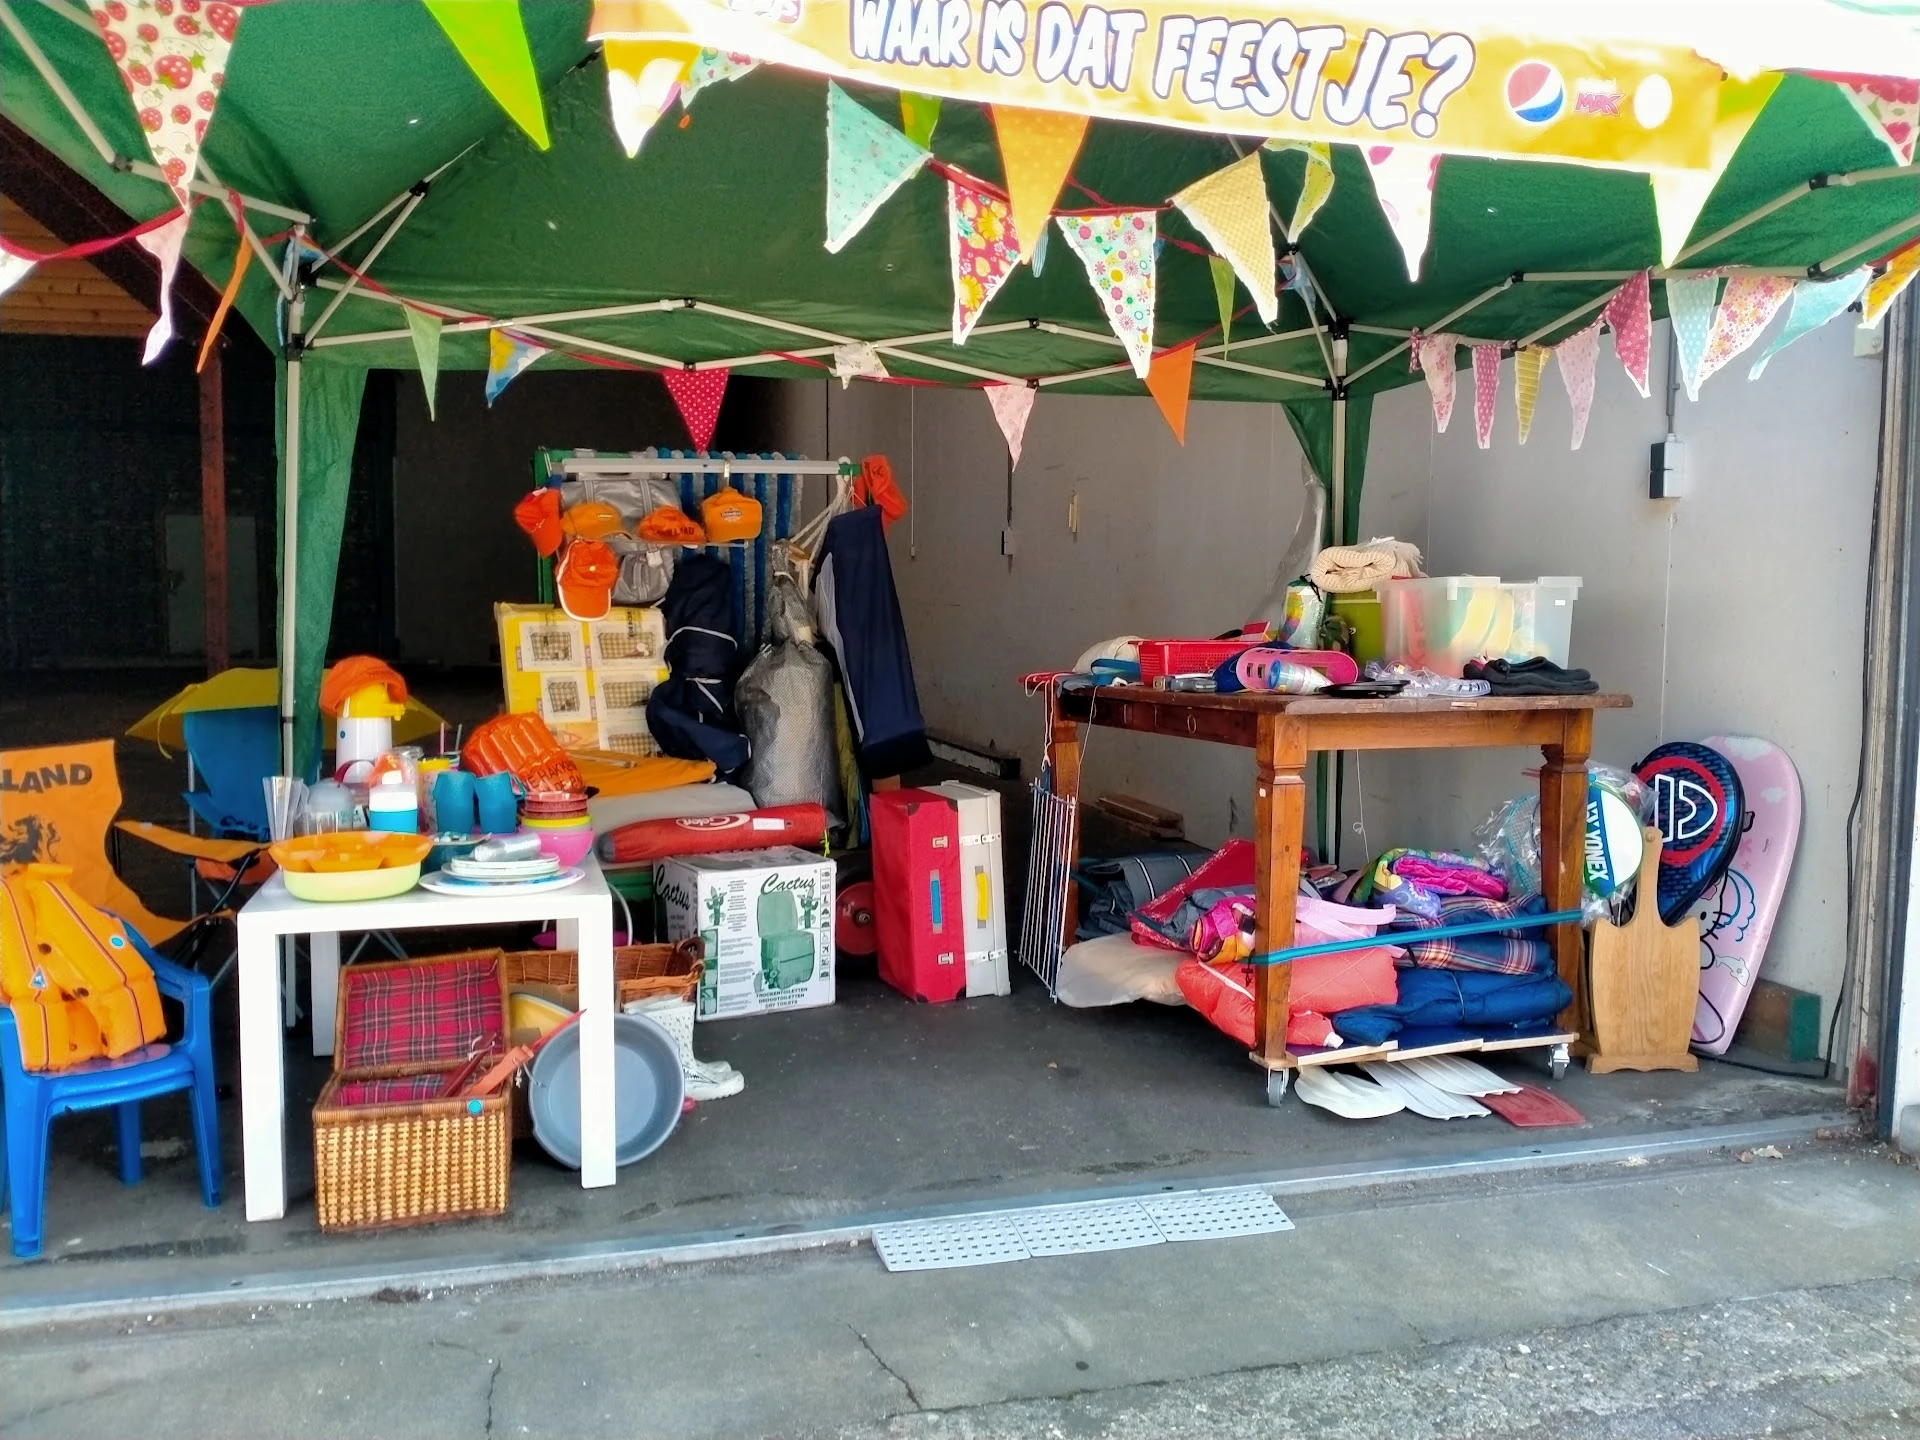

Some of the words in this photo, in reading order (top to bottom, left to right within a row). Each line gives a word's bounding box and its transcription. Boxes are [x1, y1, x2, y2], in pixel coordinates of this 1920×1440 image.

[850, 0, 972, 69] WAAR
[976, 0, 1028, 77] IS
[1033, 1, 1146, 93] DAT
[1574, 91, 1625, 116] MAX
[0, 763, 93, 793] LAND
[1584, 829, 1609, 882] YONEX
[655, 864, 690, 910] Cactus
[760, 873, 817, 895] Cactus
